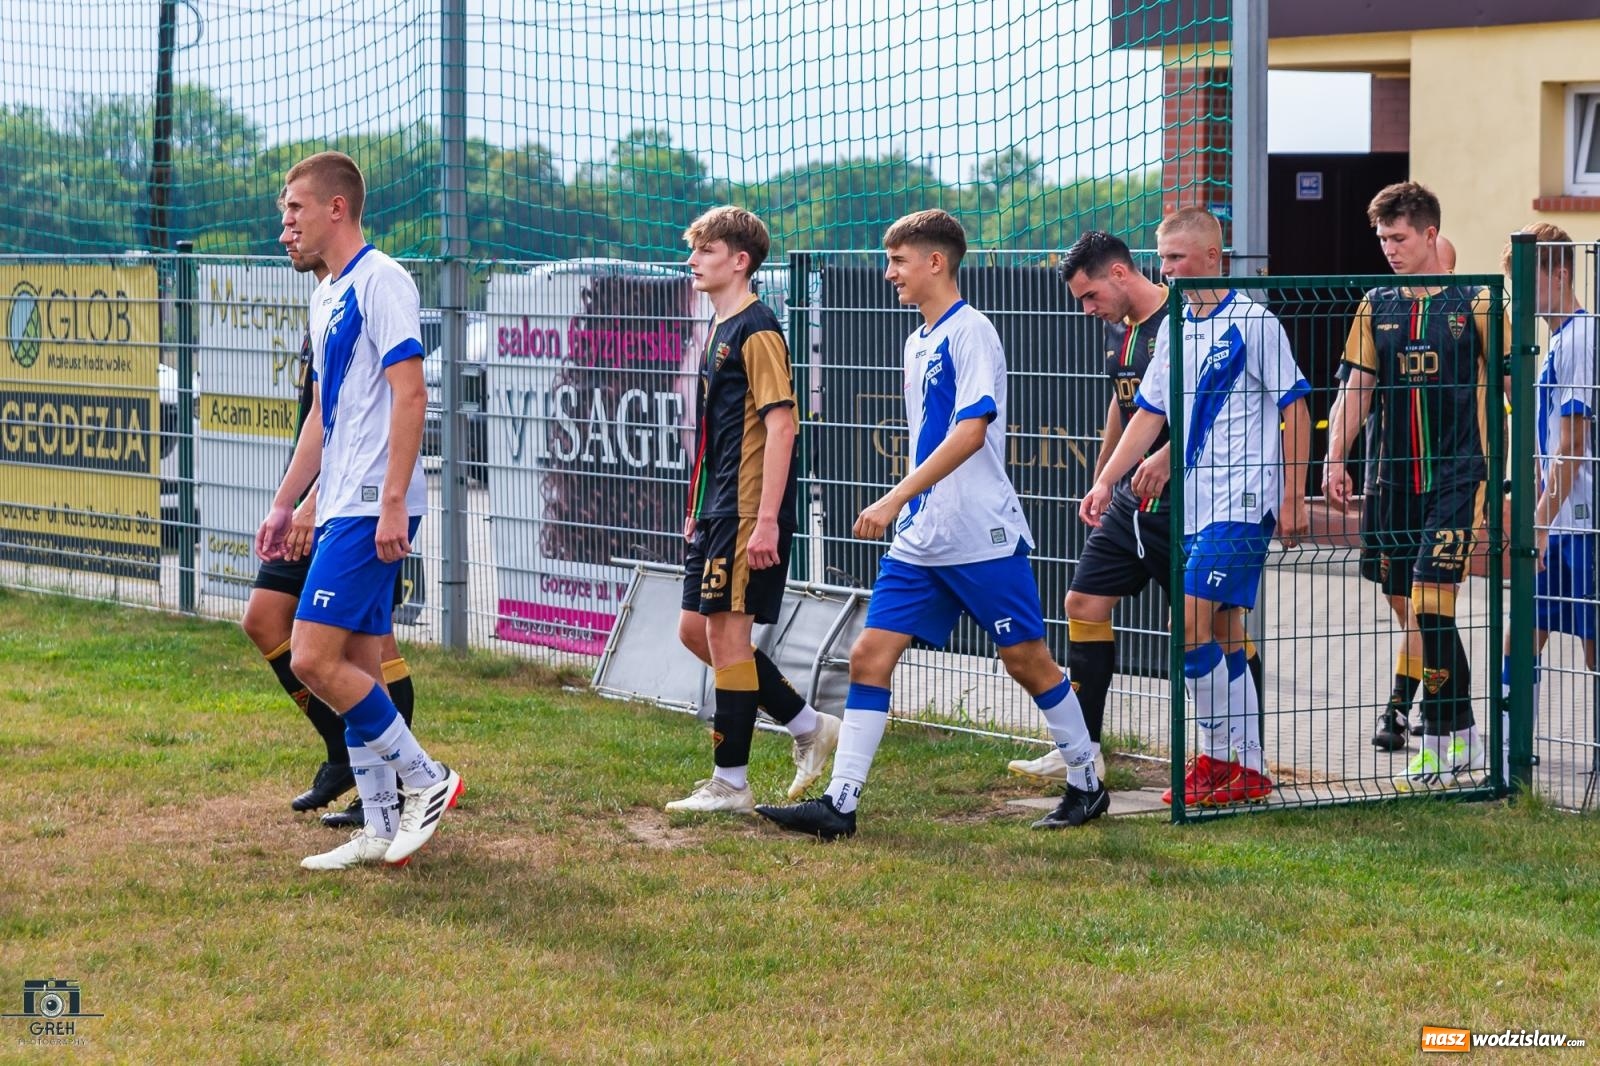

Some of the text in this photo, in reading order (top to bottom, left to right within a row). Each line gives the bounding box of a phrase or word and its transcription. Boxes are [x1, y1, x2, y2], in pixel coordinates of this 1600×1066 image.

[47, 288, 131, 346] GLOB
[497, 315, 681, 369] salon fryzjerski
[1396, 351, 1438, 375] 100
[2, 401, 146, 462] GEODEZJA
[210, 399, 294, 431] Adam Janik
[496, 384, 687, 470] VISAGE
[1432, 529, 1464, 560] 21
[701, 557, 728, 590] 25
